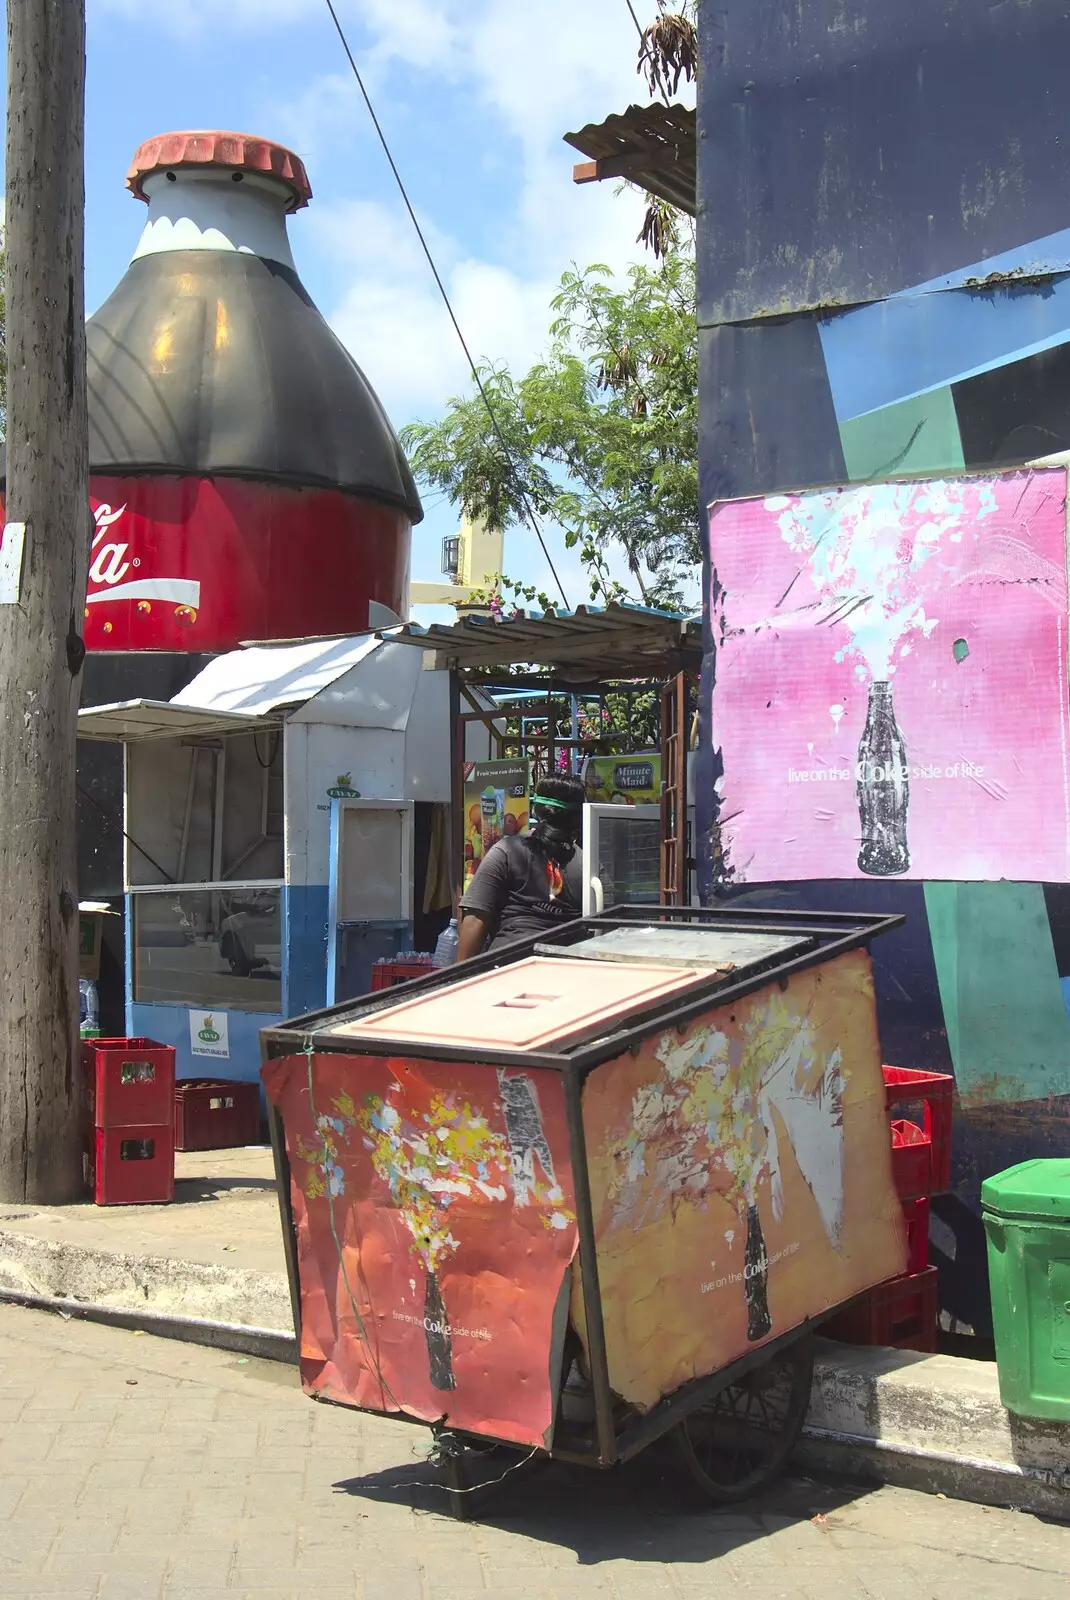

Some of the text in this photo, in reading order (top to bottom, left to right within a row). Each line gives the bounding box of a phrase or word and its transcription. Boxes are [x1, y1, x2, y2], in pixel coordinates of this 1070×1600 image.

[616, 766, 651, 776] Minute
[621, 776, 646, 786] Maid
[788, 760, 985, 782] live on the Coke side of life
[701, 1282, 714, 1293] live
[716, 1277, 727, 1288] on
[728, 1272, 743, 1284] the
[743, 1258, 769, 1280] Coke
[423, 1317, 452, 1336] Coke
[453, 1326, 469, 1337] side
